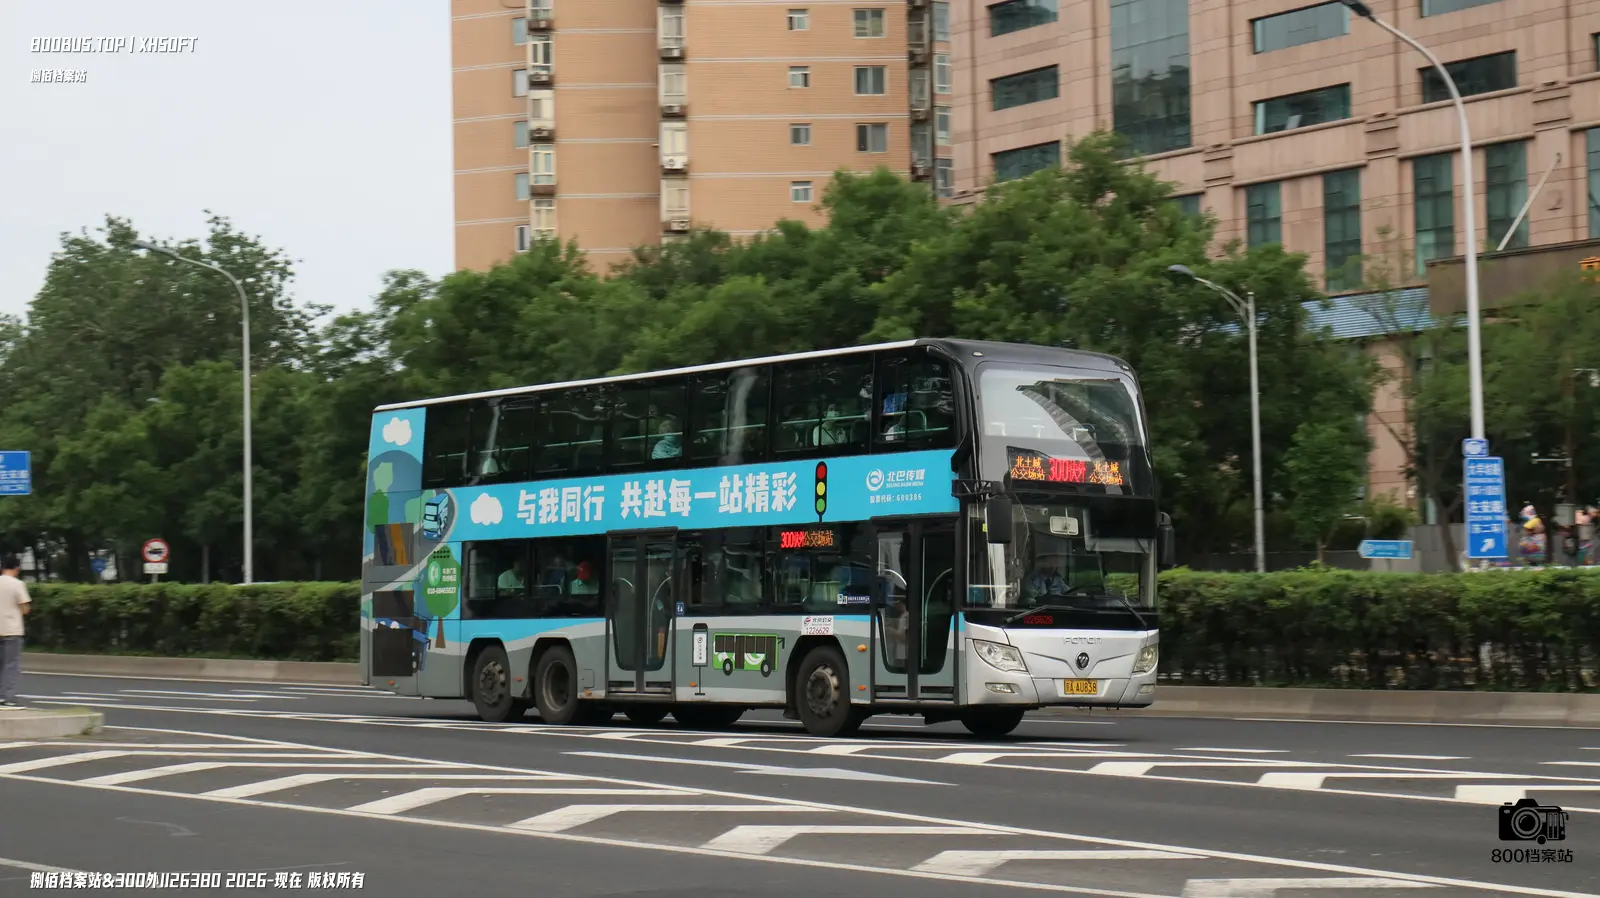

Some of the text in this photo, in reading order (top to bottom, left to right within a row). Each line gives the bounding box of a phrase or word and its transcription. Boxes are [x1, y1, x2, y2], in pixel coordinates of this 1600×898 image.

[1015, 455, 1042, 468] 北土城
[886, 468, 926, 482] 北巴传媒
[516, 471, 798, 525] 与我同行 共赴每一站精彩
